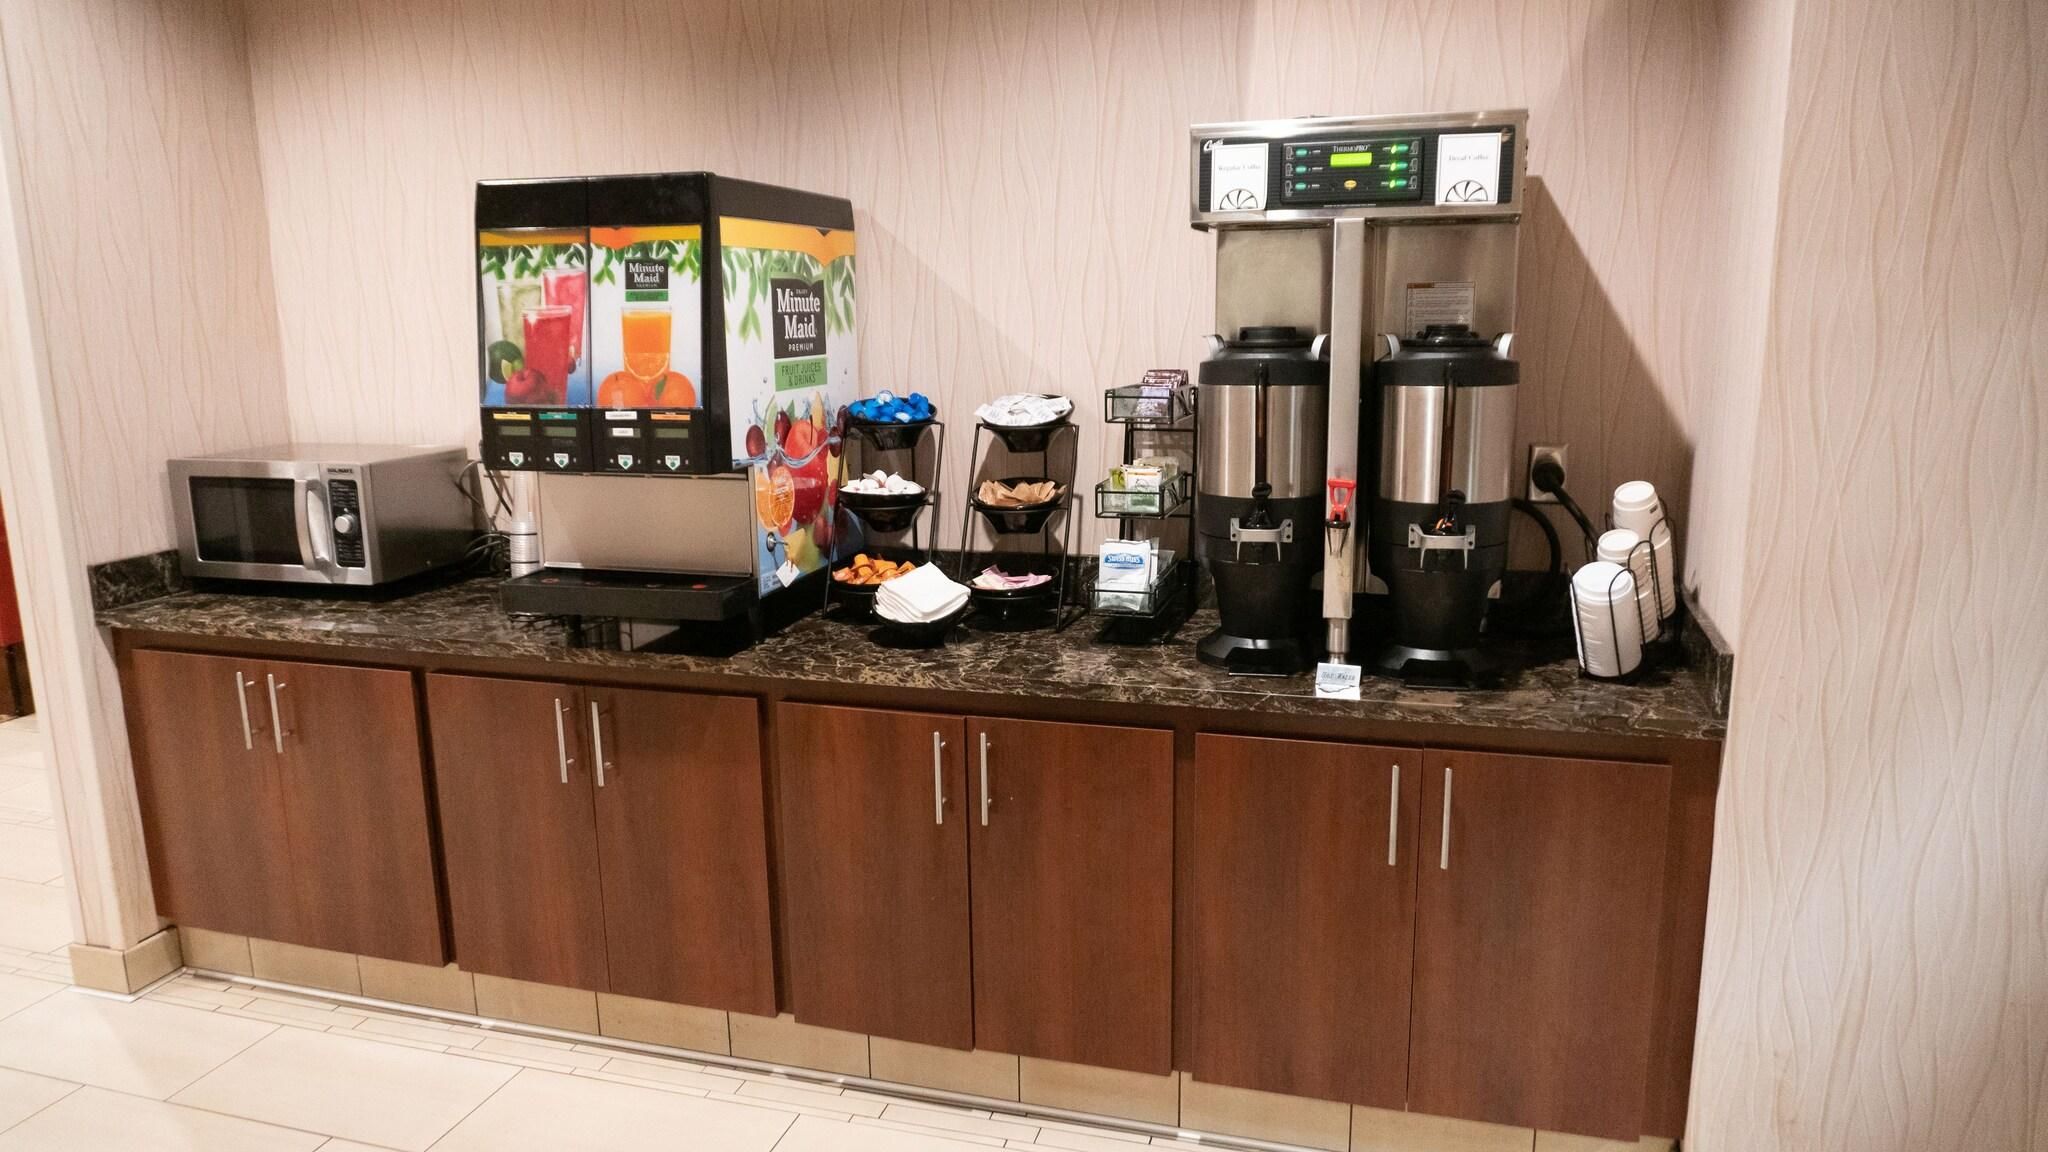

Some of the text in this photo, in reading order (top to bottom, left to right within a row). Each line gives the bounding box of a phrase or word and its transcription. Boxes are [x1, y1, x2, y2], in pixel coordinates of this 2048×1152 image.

[628, 262, 665, 273] Minute
[634, 272, 660, 283] Maid
[776, 288, 820, 312] Minute
[784, 314, 816, 339] Maid
[788, 343, 814, 352] PREMIUM
[781, 361, 822, 376] FRUIT JUICES
[794, 374, 816, 385] DRINKS
